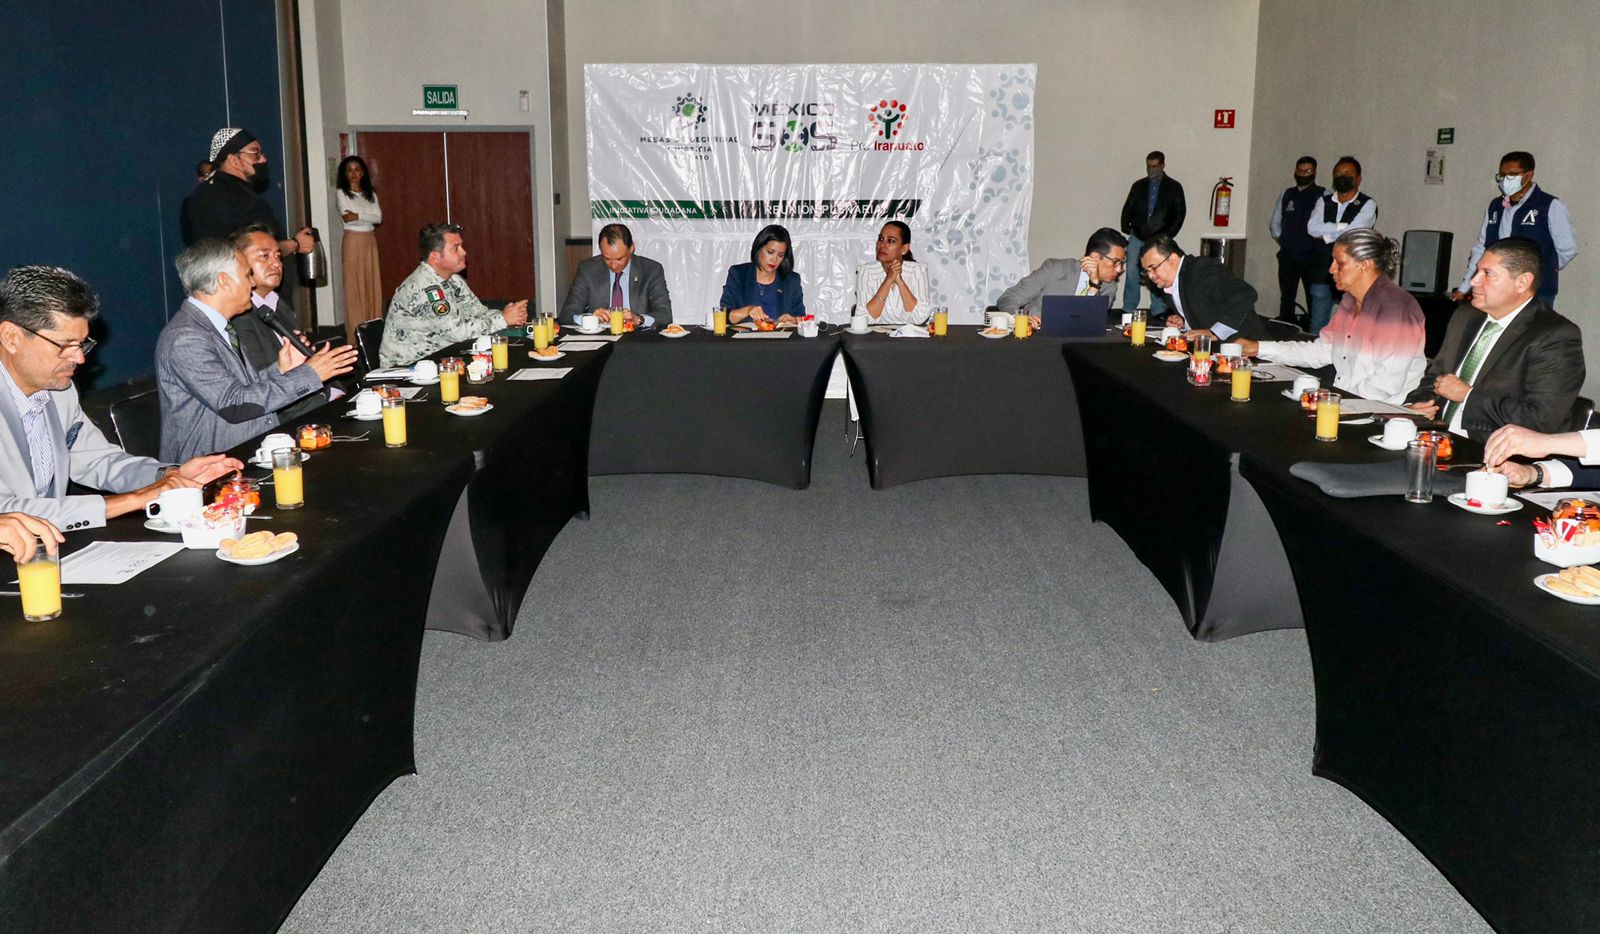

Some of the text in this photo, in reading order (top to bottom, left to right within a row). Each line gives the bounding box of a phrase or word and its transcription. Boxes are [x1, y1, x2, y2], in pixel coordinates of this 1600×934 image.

[426, 91, 455, 104] SALIDA
[850, 141, 925, 153] Pro Irapuato
[764, 203, 818, 215] REUNIÓN
